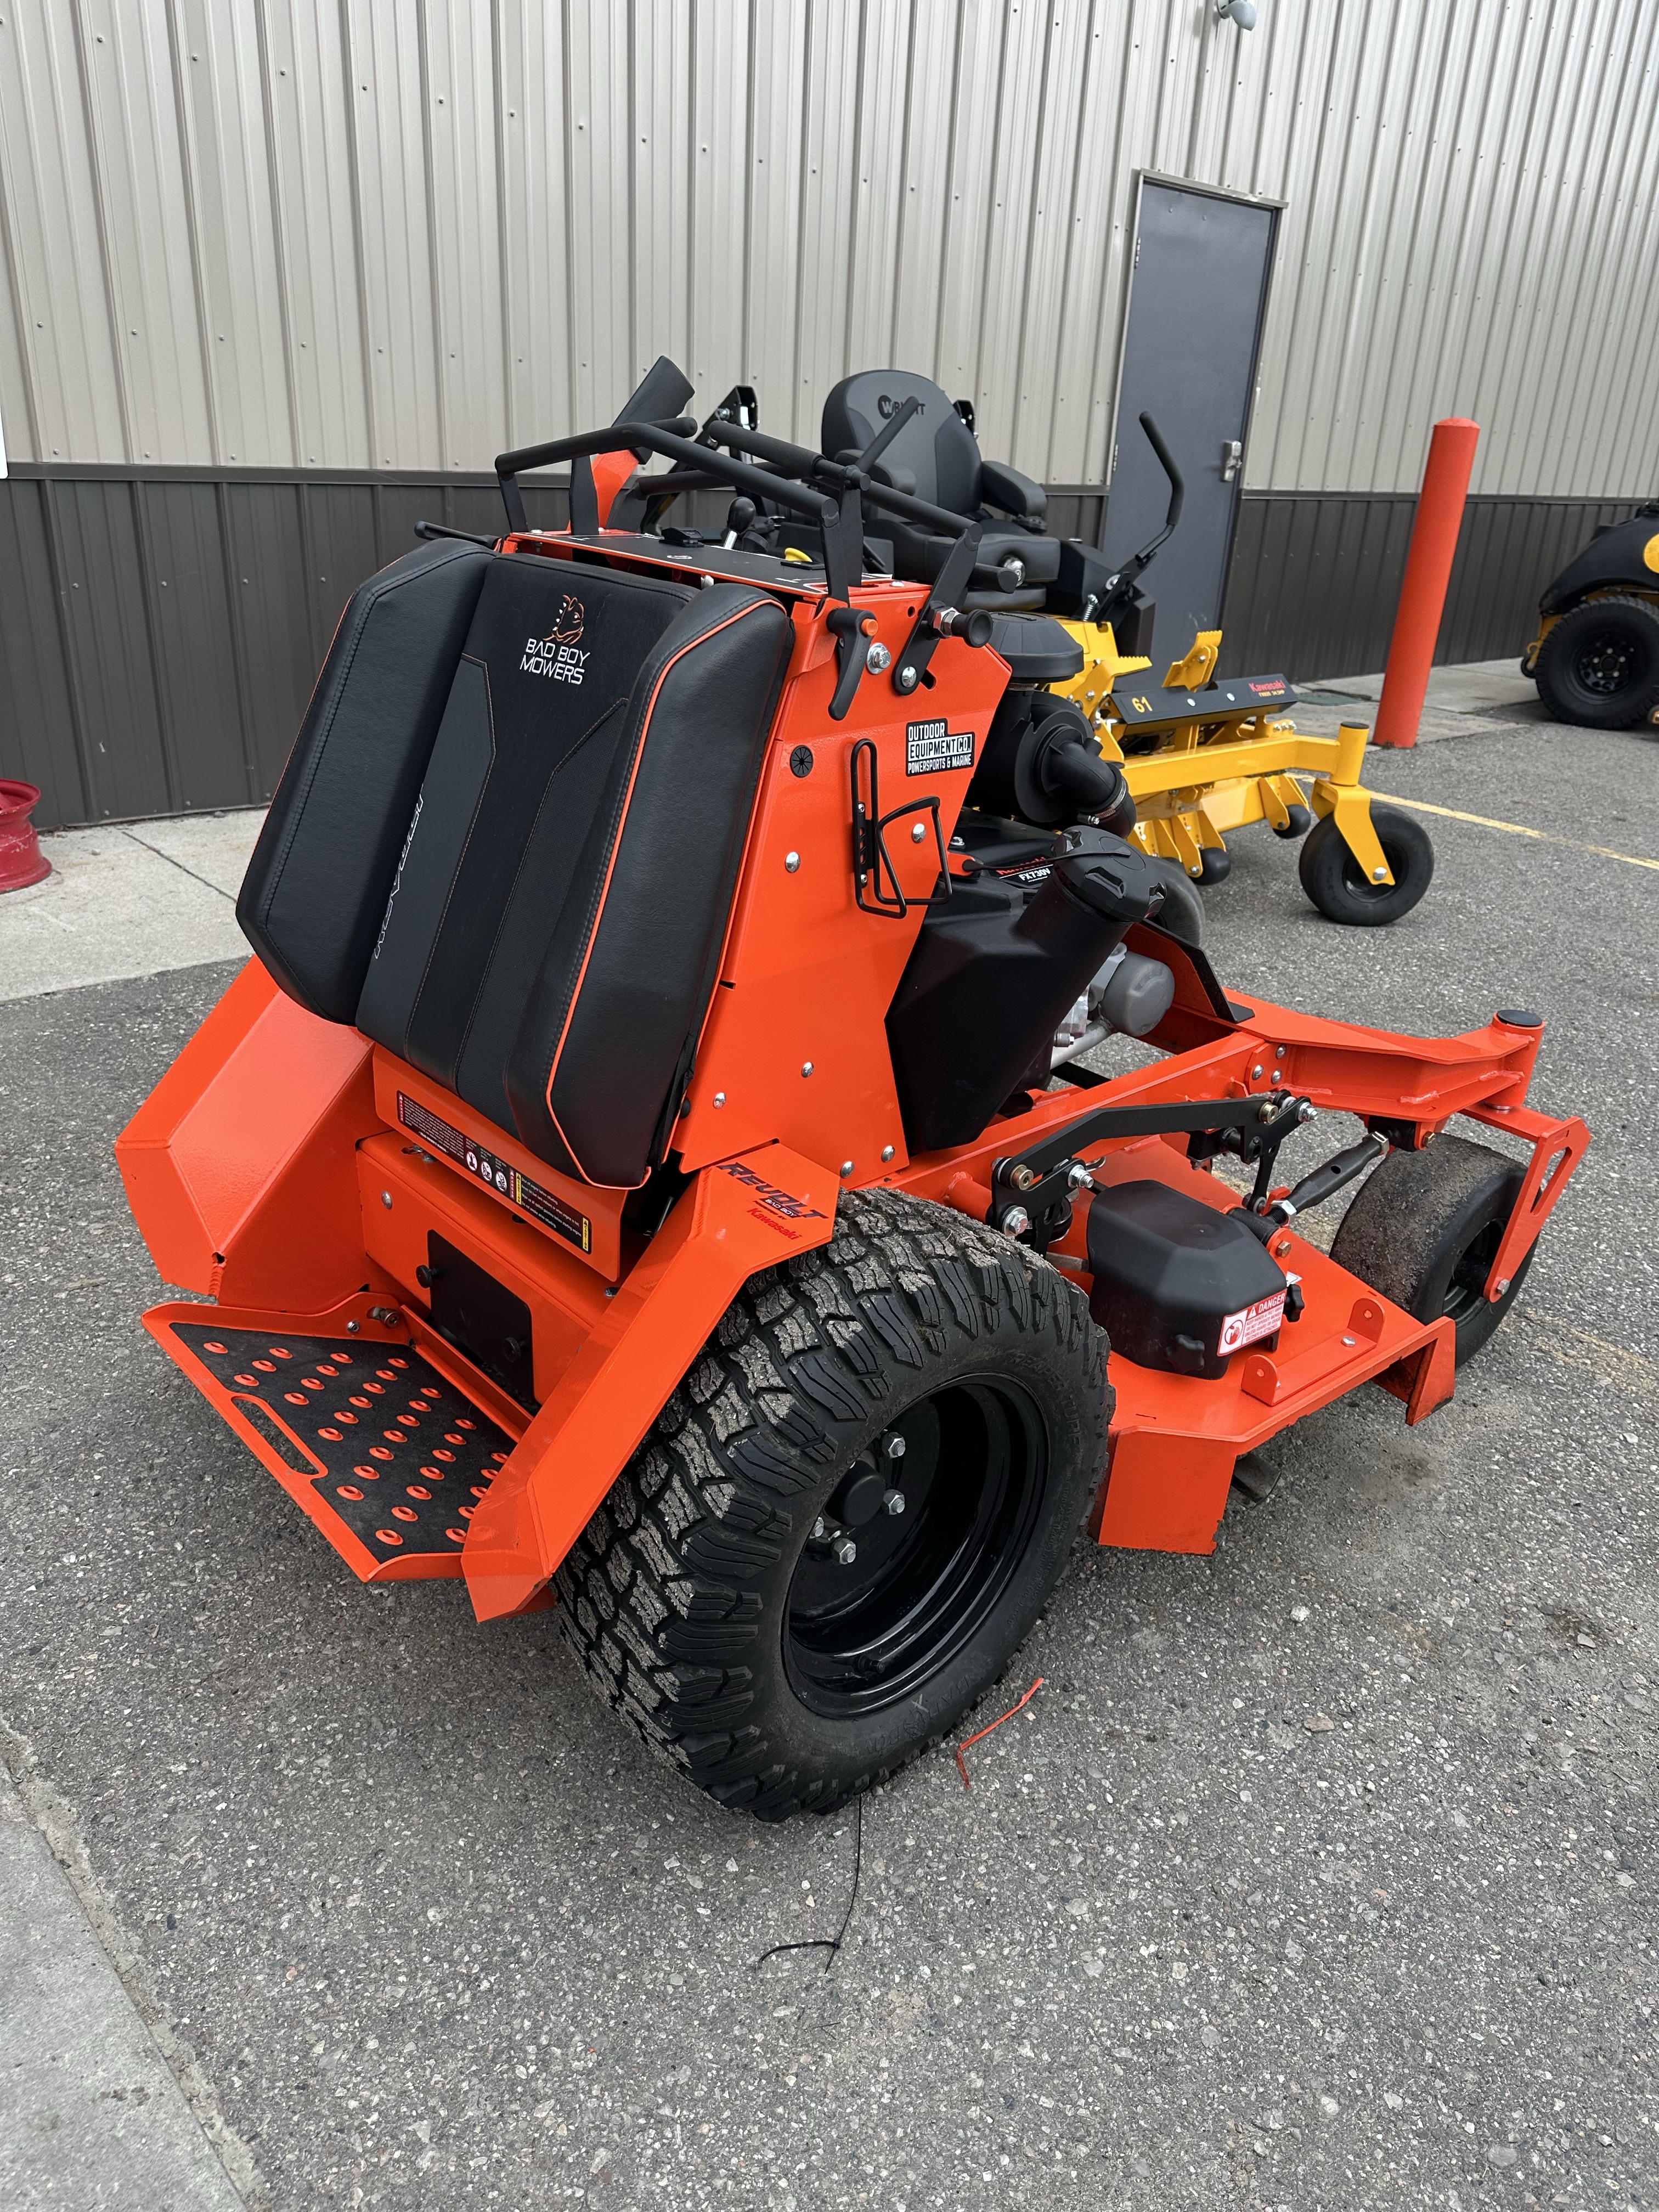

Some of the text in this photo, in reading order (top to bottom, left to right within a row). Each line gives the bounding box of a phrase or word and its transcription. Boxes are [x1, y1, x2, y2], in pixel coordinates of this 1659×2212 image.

[526, 639, 590, 666] BAD BOY
[520, 654, 585, 685] MOWERS
[1249, 680, 1286, 692] Kawasaki
[1132, 696, 1153, 713] 61
[908, 723, 945, 742] OUTDOOR
[910, 737, 972, 759] EQUIPMENT CO.
[908, 754, 972, 775] POWERSPORTS & MARINE
[1018, 867, 1051, 881] FX730V
[765, 1199, 781, 1208] BAD
[780, 1207, 797, 1217] BOY
[747, 1207, 803, 1240] Kawasaki
[1259, 1293, 1285, 1313] DANGER
